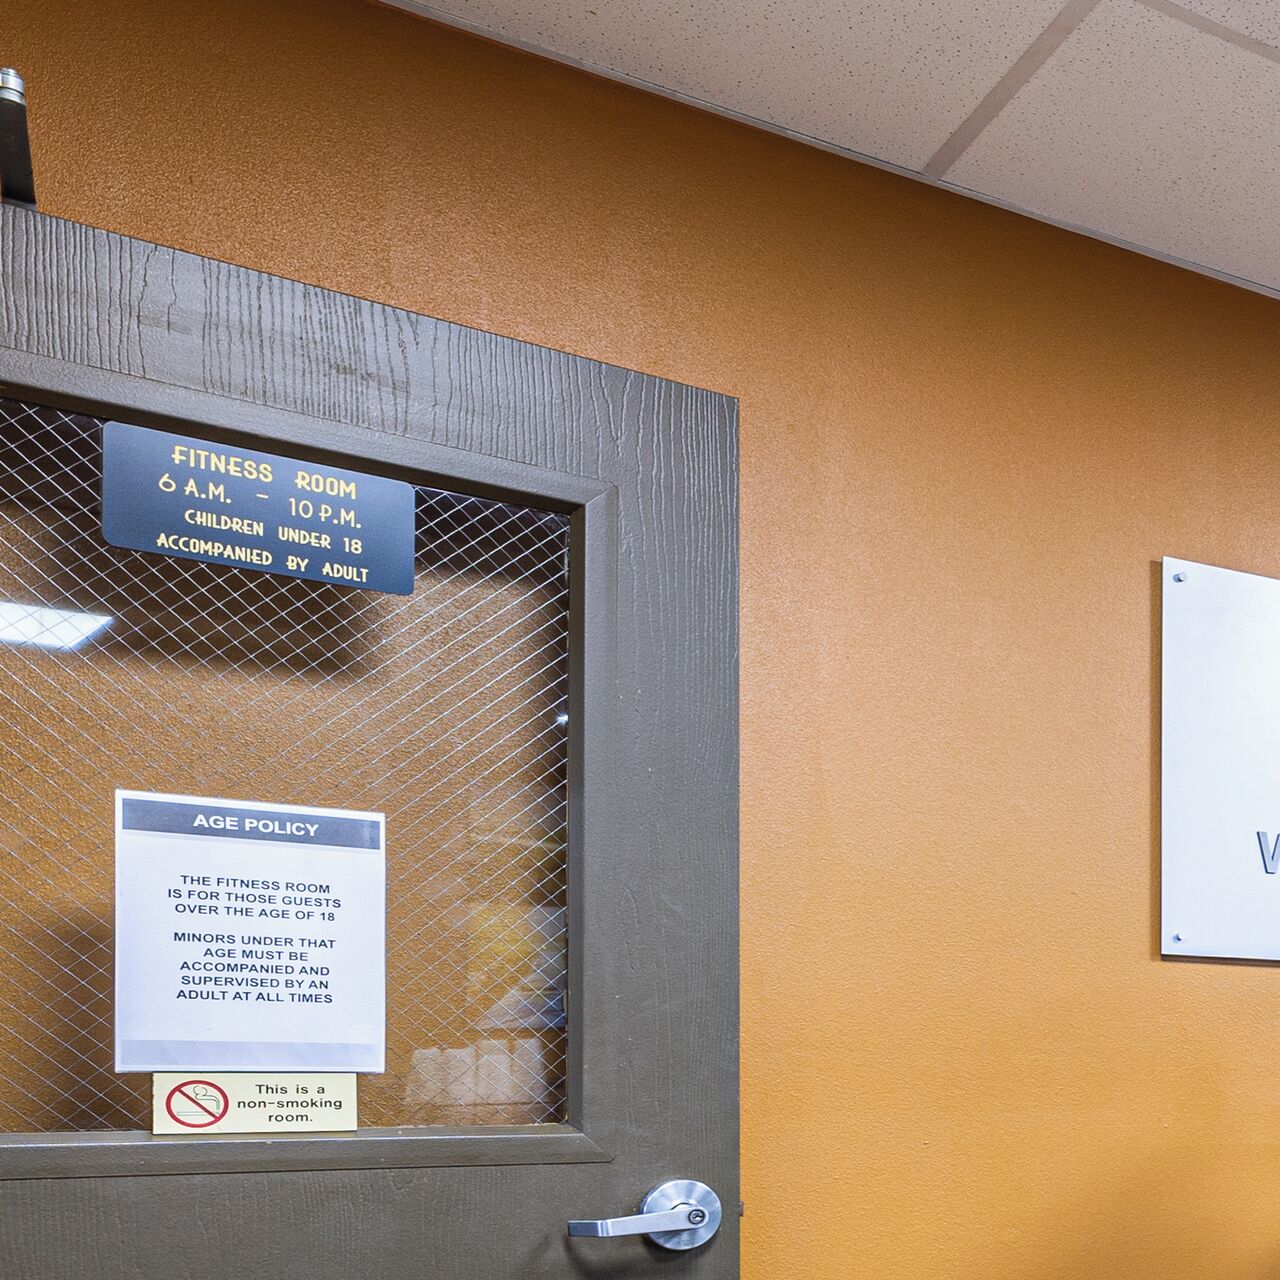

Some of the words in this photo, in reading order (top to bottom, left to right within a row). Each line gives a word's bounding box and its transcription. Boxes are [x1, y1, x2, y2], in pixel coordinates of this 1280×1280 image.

[172, 444, 273, 482] FITNESS
[295, 470, 356, 499] ROOM
[159, 473, 176, 491] 6
[184, 479, 231, 503] A.M.
[289, 498, 313, 518] 10
[319, 504, 361, 528] P.M.
[185, 510, 263, 536] CHILDREN
[279, 526, 331, 549] UNDER
[344, 538, 362, 554] 18
[157, 533, 272, 565] ACCOMPANIED
[286, 556, 309, 571] BY
[322, 562, 368, 582] ADULT
[193, 815, 238, 830] AGE
[245, 819, 318, 836] POLICY
[181, 875, 210, 886] THE
[217, 878, 280, 890] FITNESS
[286, 882, 329, 893] ROOM
[169, 889, 182, 898] IS
[188, 890, 219, 900] FOR
[225, 892, 276, 904] THOSE
[282, 896, 341, 908] GUESTS
[175, 904, 218, 914] OVER
[224, 906, 253, 916] THE
[259, 909, 289, 919] AGE
[295, 911, 314, 919] OF
[321, 913, 334, 921] 18
[174, 932, 235, 944] MINORS
[242, 936, 293, 946] UNDER
[299, 938, 335, 948] THAT
[204, 948, 236, 958] AGE
[242, 950, 283, 960] MUST
[289, 952, 308, 961] BE
[180, 961, 294, 974] ACCOMPANIED
[299, 966, 329, 975] AND
[182, 976, 279, 987] SUPERVISED
[285, 979, 304, 988] BY
[309, 981, 328, 989] AN
[177, 990, 228, 1000] ADULT
[233, 992, 251, 1000] AT
[256, 992, 284, 1001] ALL
[289, 993, 332, 1003] TIMES
[255, 1083, 288, 1095] This
[296, 1085, 308, 1095] is
[316, 1086, 325, 1095] a
[238, 1098, 342, 1110] non-smoking
[268, 1114, 313, 1123] room.
